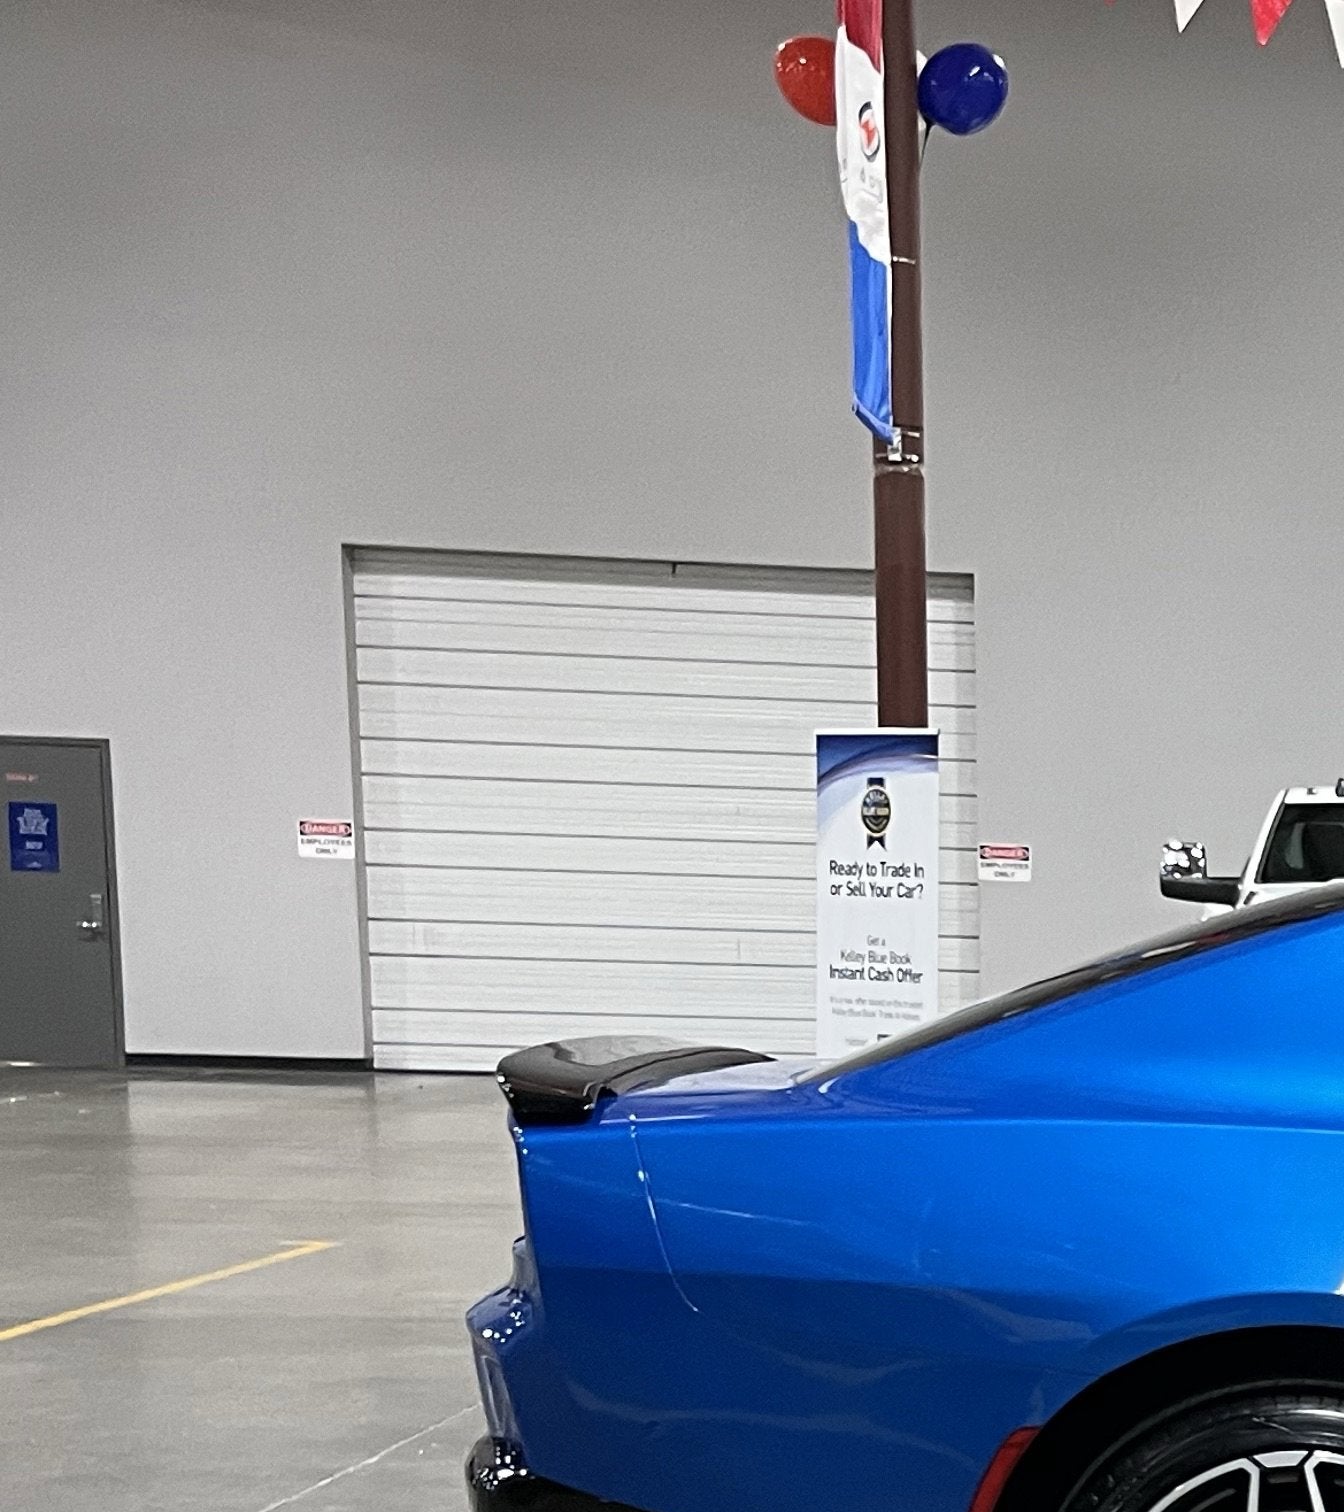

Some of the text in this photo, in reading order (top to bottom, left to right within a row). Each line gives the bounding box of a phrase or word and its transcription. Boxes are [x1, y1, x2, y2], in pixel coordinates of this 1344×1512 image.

[829, 859, 925, 881] Ready to Trade In
[830, 880, 924, 899] or Sell Your Car?
[868, 949, 887, 964] Blue
[889, 950, 912, 965] Book
[829, 963, 924, 984] Instant Cash Offer
